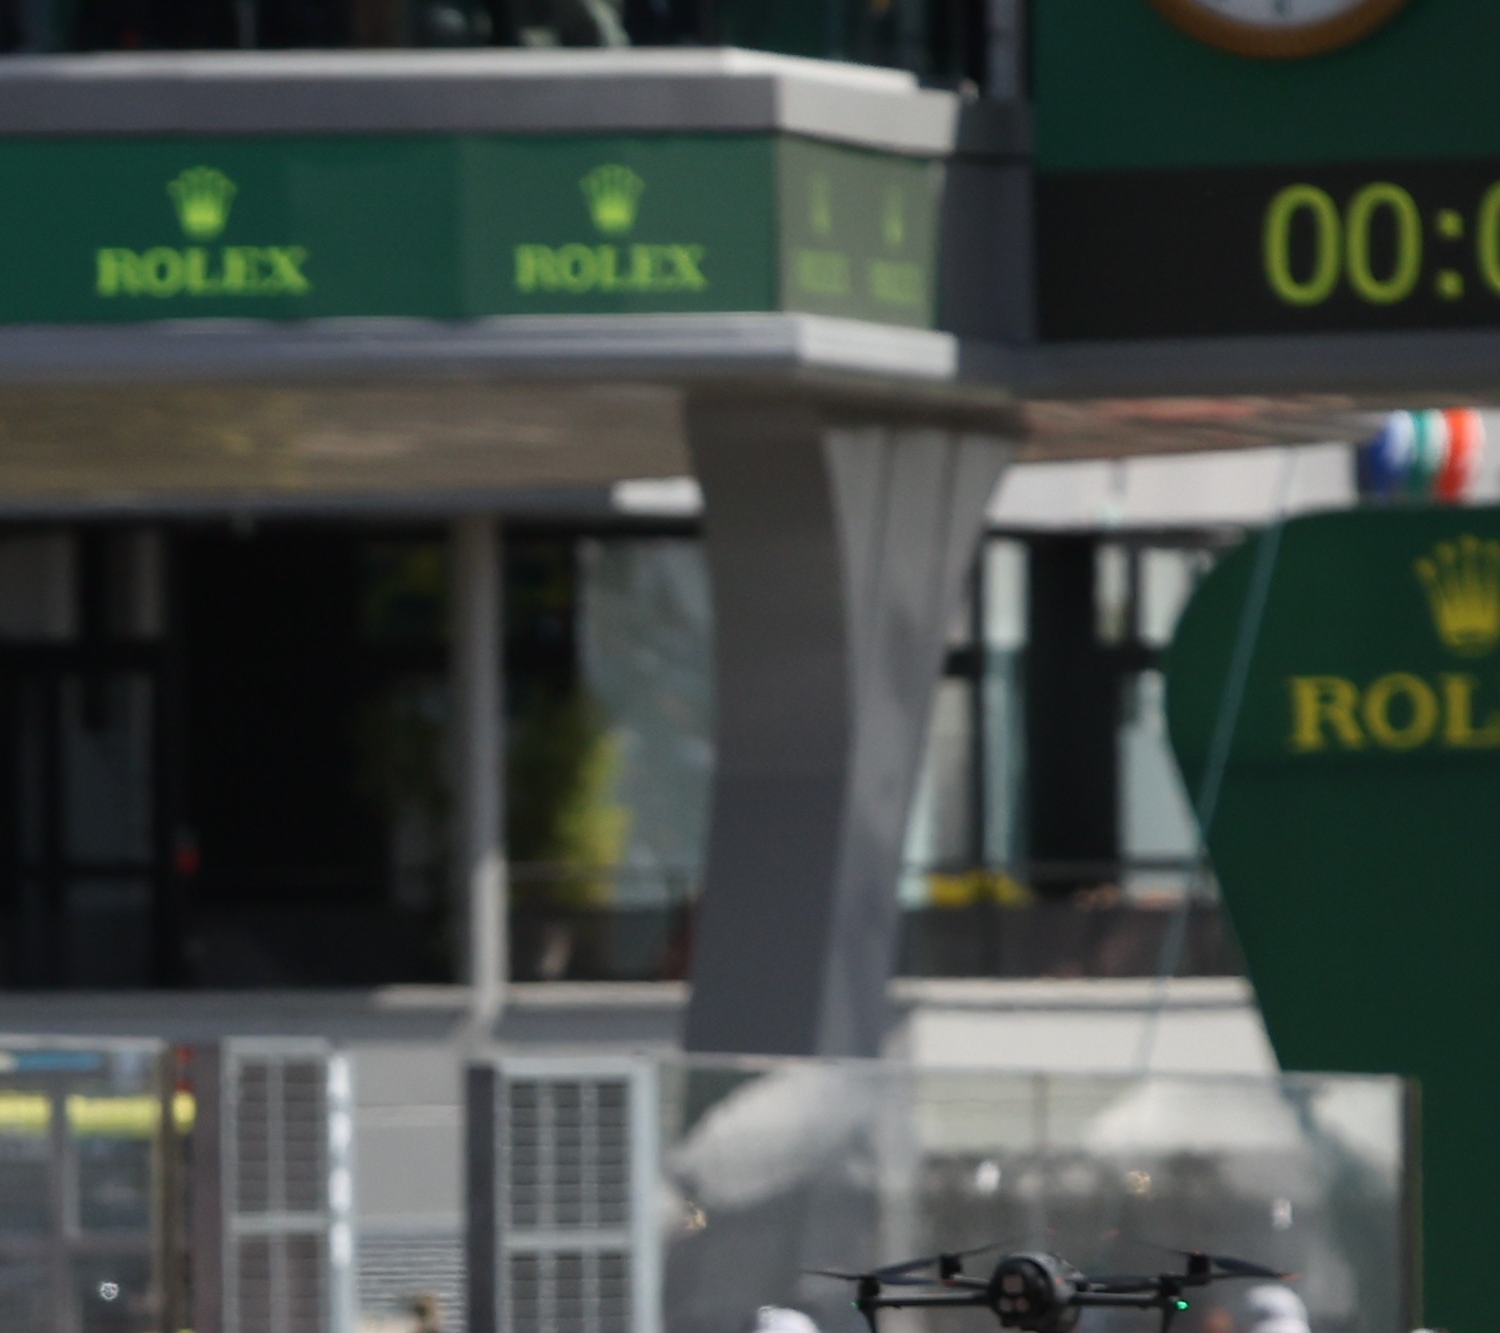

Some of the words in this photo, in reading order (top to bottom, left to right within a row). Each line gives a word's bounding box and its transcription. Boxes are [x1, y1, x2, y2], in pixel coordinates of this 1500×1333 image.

[516, 244, 706, 291] ROLEX
[1263, 183, 1500, 306] 00:
[97, 247, 309, 295] ROLEX
